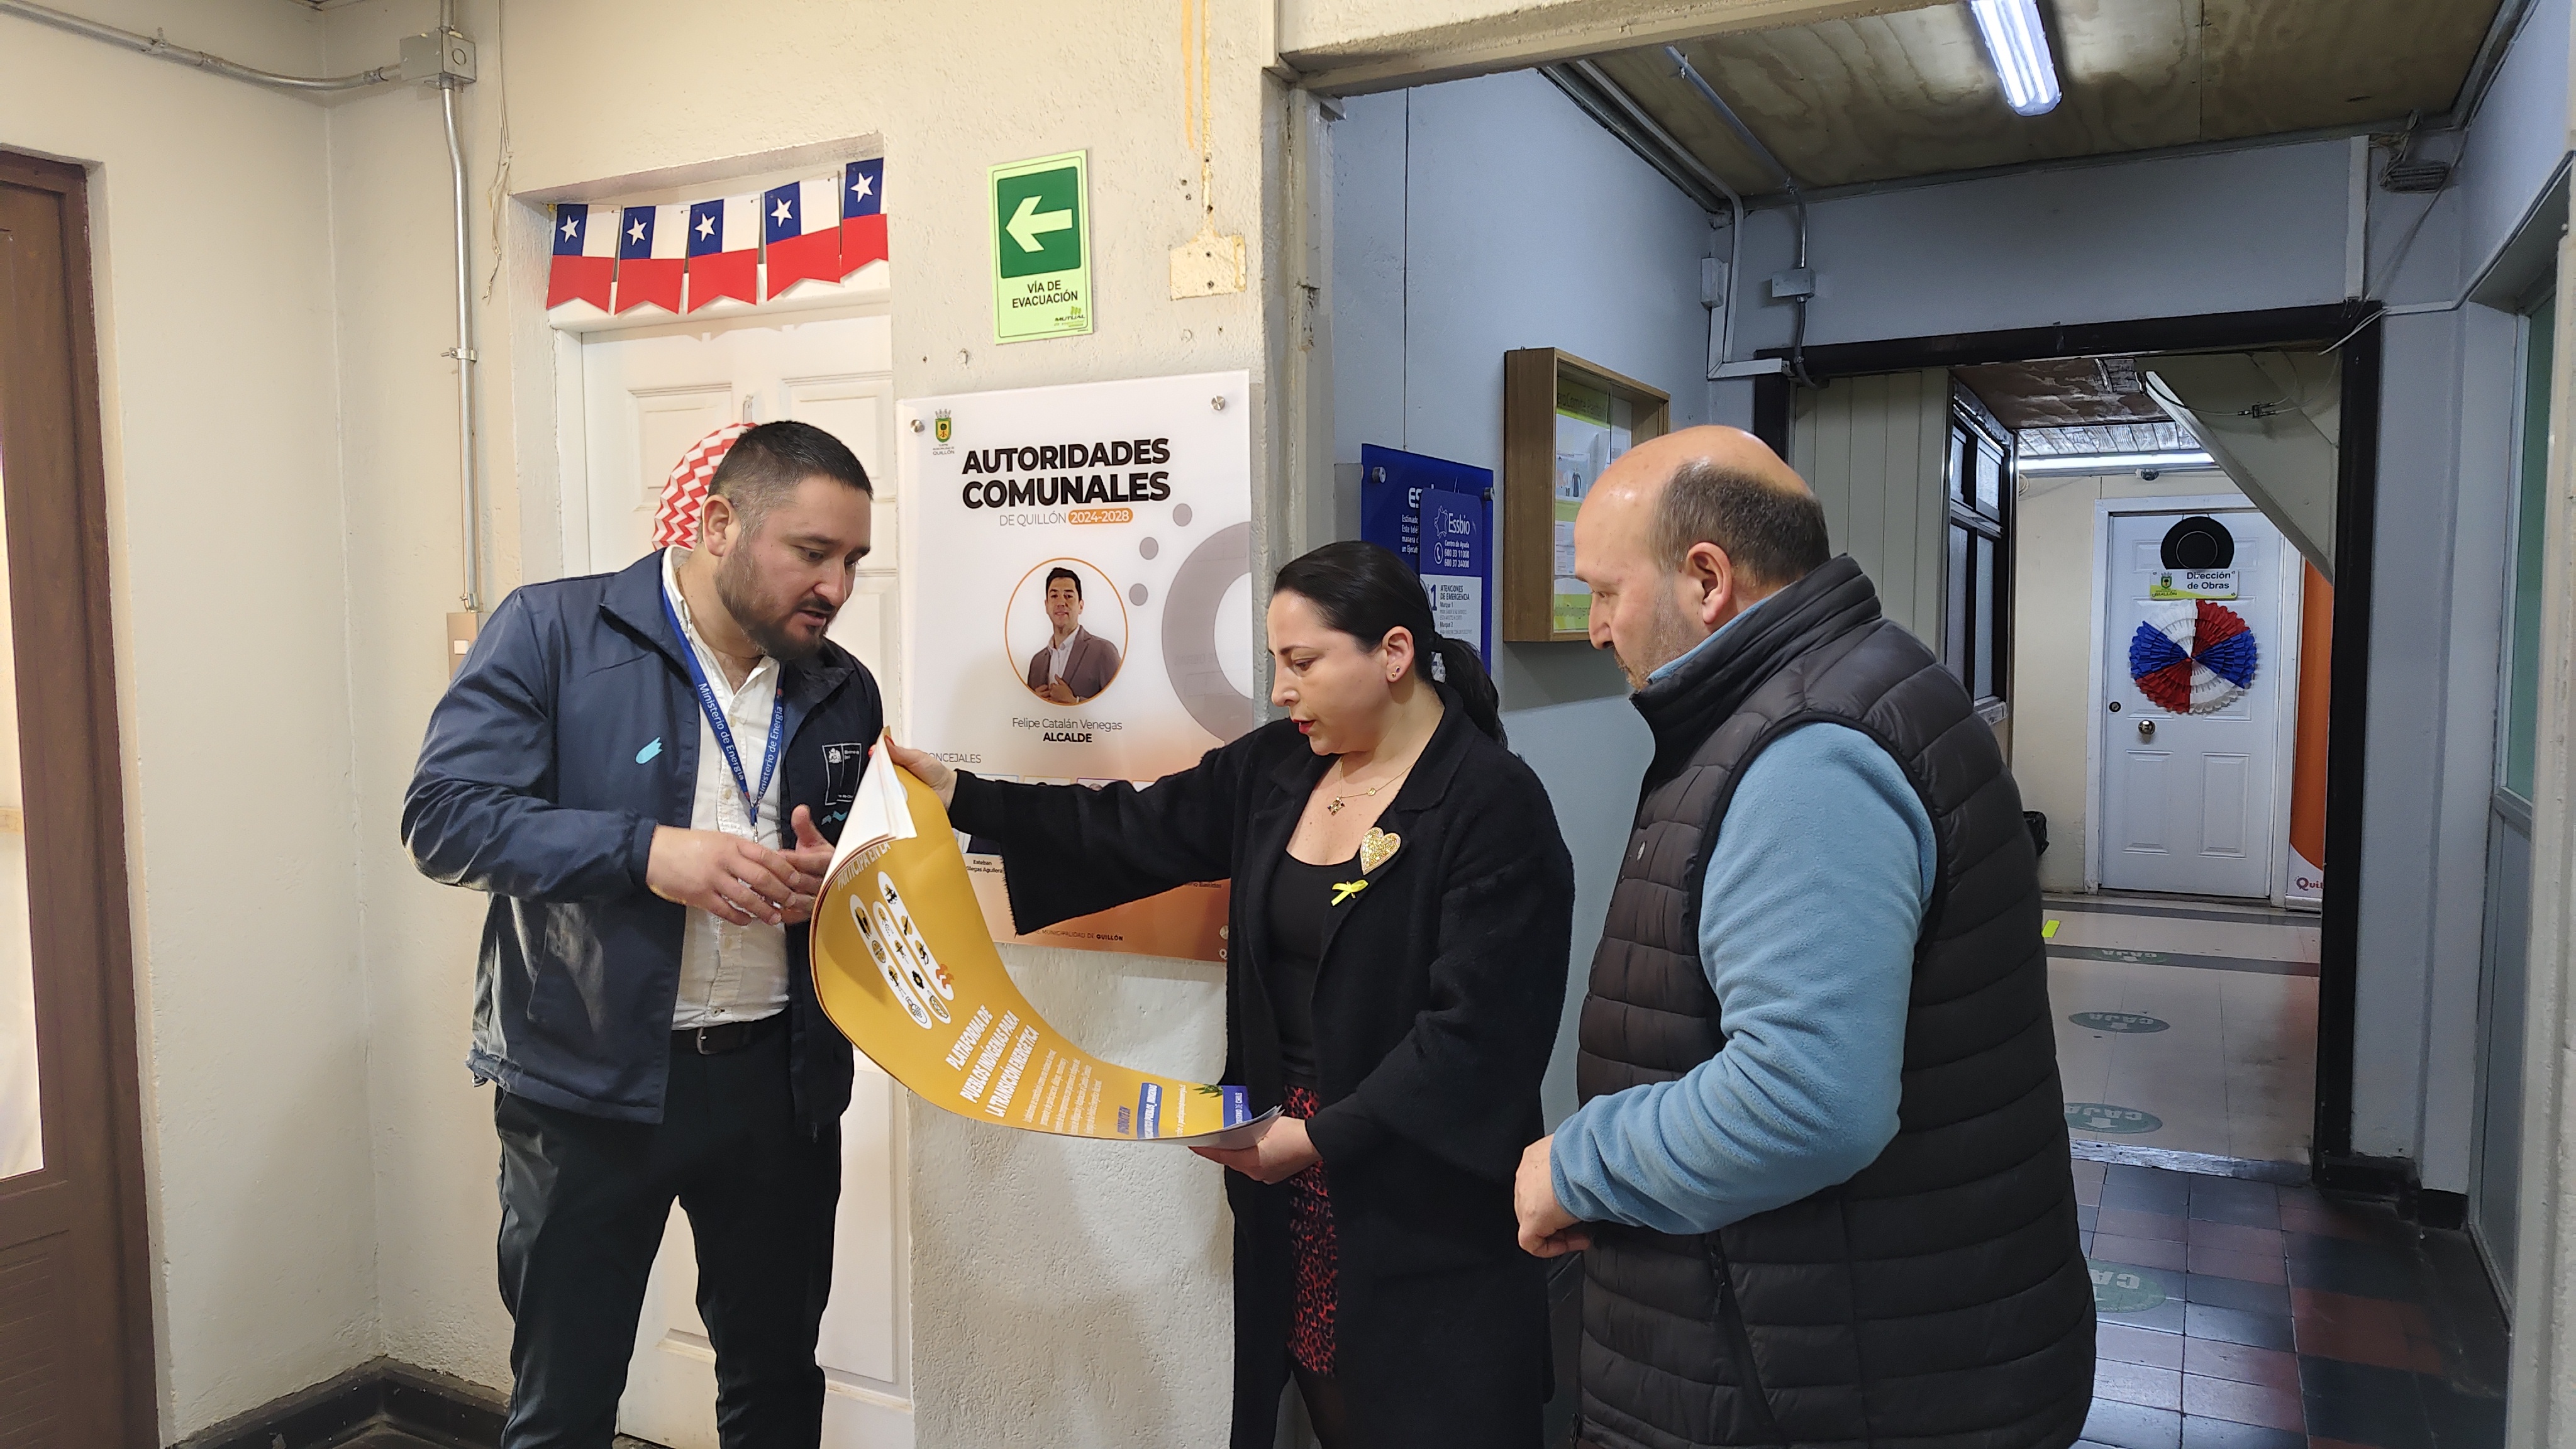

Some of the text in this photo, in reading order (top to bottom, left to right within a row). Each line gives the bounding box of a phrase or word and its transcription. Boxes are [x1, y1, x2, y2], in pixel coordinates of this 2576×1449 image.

[1027, 280, 1062, 293] VÍA DE
[1012, 289, 1078, 308] EVACUACIÓN
[962, 438, 1170, 475] AUTORIDADES
[962, 471, 1171, 509] COMUNALES
[999, 510, 1130, 527] DE QUILLÓN 2024-2028
[1448, 513, 1470, 535] Essbio
[1444, 548, 1452, 557] 600
[1452, 549, 1457, 558] 33
[1444, 558, 1452, 567] 600
[1452, 559, 1457, 567] 37
[1430, 584, 1438, 611] 1
[698, 683, 724, 731] Ministerio
[720, 731, 730, 744] de
[1012, 718, 1123, 733] Felipe Catalán Venegas
[1043, 732, 1092, 743] ALCALDE
[924, 752, 982, 763] ONCEJALES
[757, 755, 774, 799] Ministerio
[768, 741, 777, 753] de
[837, 842, 891, 891] PARTICIPA EN LA
[1042, 930, 1086, 938] MUNICIPALIDAD
[945, 1004, 994, 1072] PLATAFORMA DE
[1008, 1024, 1040, 1071] ENERGÉTICA
[959, 1009, 1020, 1104] PUEBLOS INDÍGENAS PARA
[989, 1063, 1023, 1109] TRANSICIÓN
[984, 1105, 1007, 1118] LA
[2065, 1106, 2143, 1121] CAJA
[2089, 1269, 2140, 1290] CA
